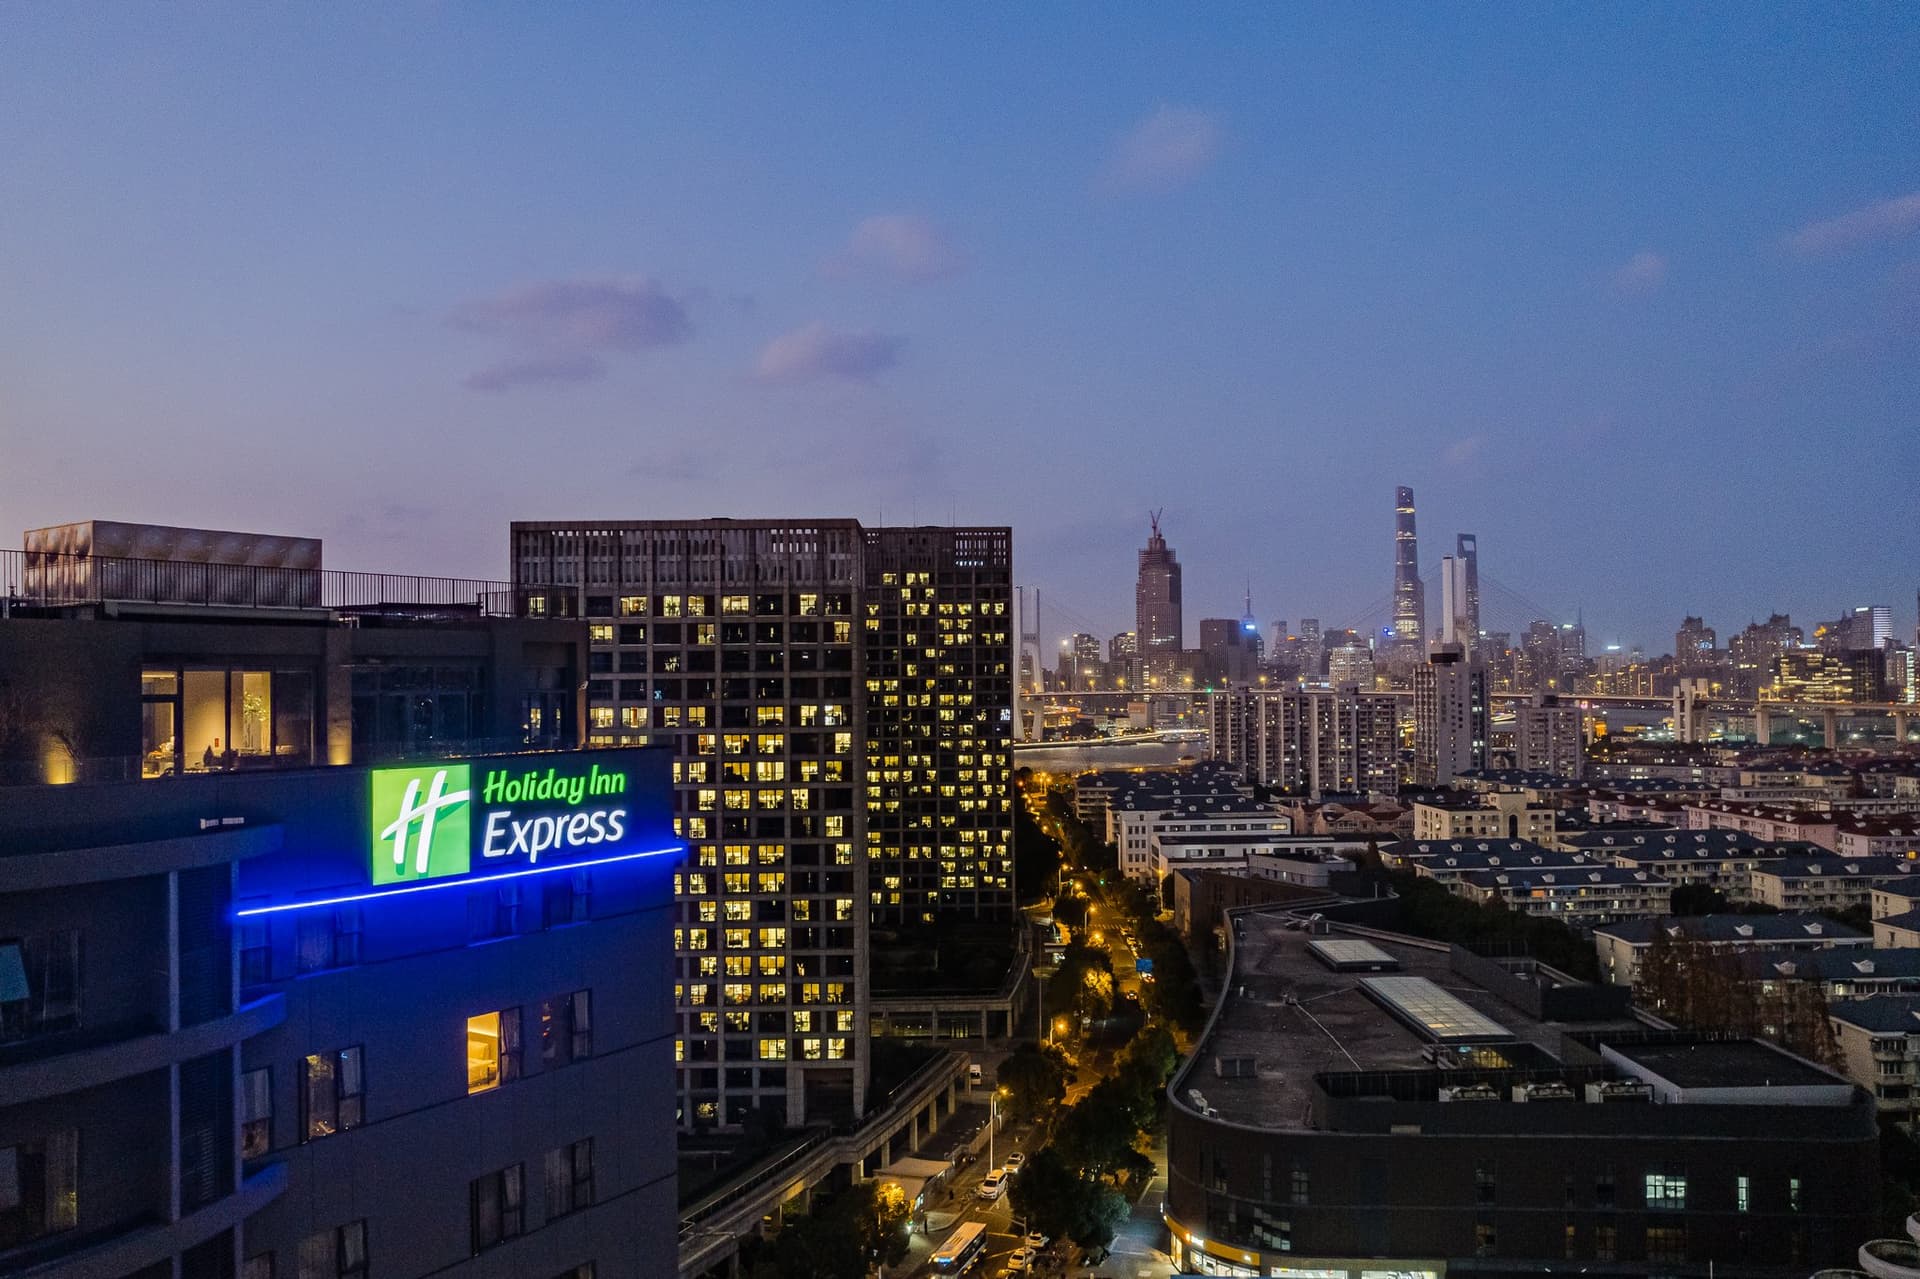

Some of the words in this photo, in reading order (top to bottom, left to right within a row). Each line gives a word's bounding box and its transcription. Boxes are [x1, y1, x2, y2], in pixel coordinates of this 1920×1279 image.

[483, 768, 585, 805] Holiday
[589, 764, 625, 795] Inn
[483, 809, 626, 863] Express
